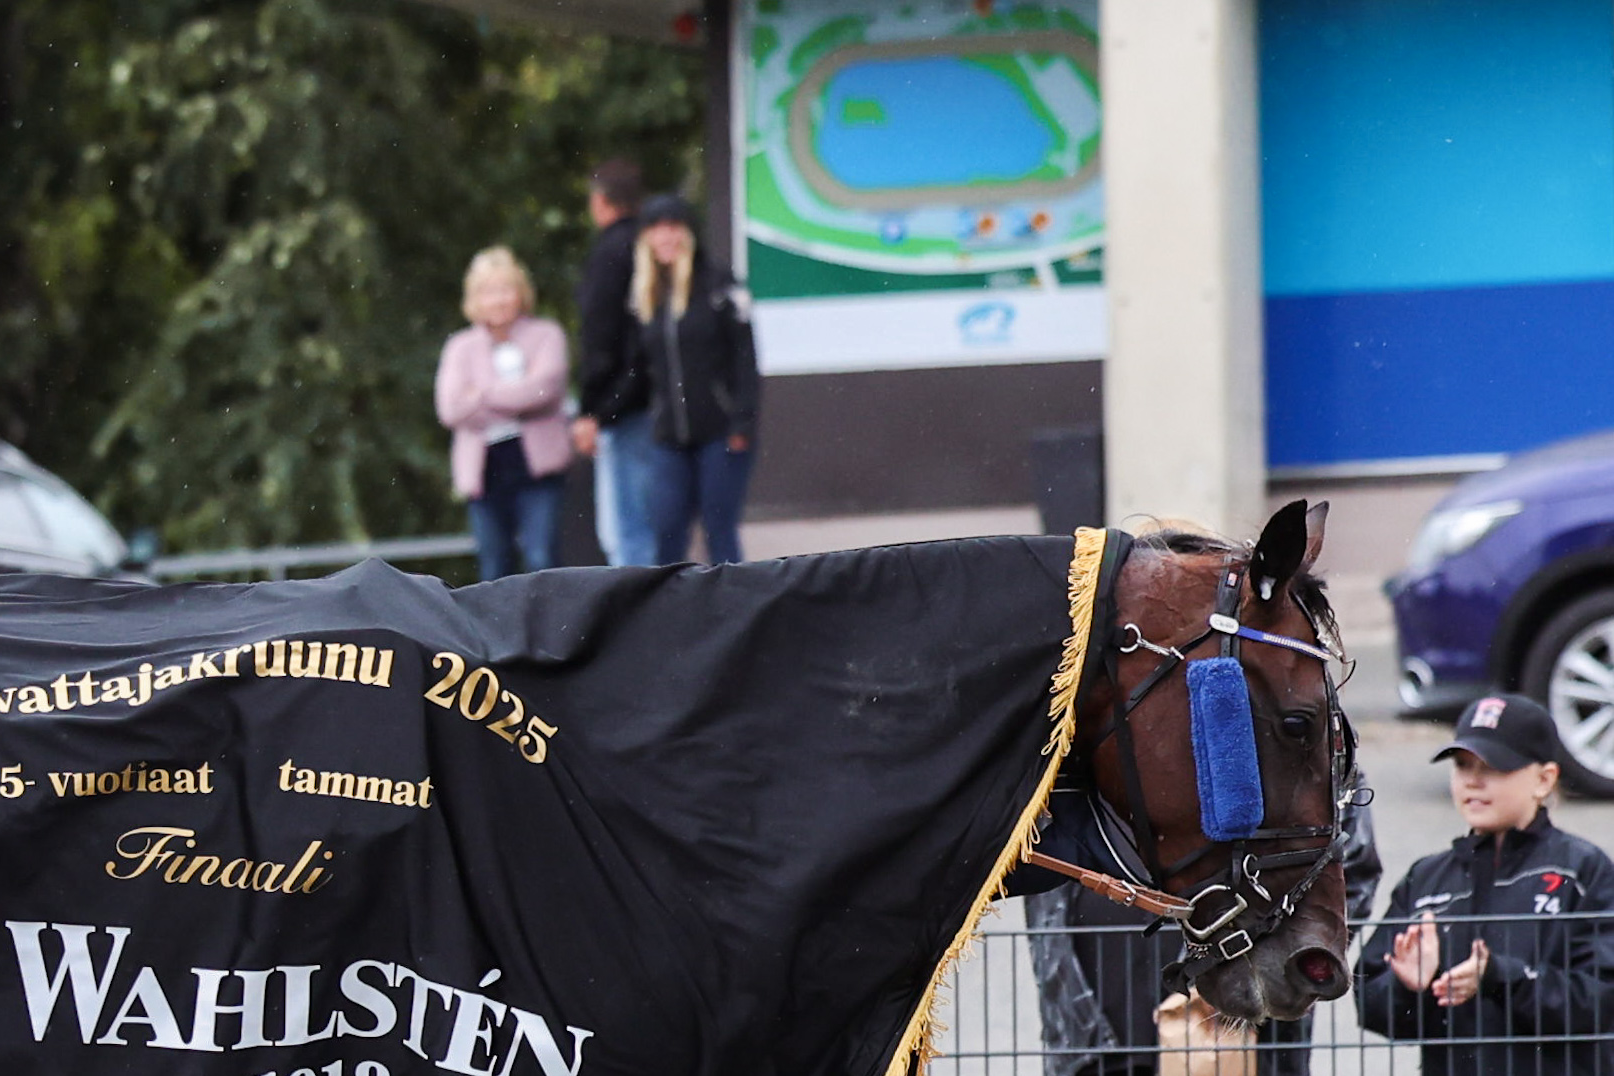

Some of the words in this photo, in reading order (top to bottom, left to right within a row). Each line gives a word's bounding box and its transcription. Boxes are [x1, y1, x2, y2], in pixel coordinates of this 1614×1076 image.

[423, 651, 559, 766] 2025
[48, 760, 214, 798] vuotiaat
[278, 758, 434, 810] tammat
[104, 827, 333, 895] Finaali
[1534, 894, 1560, 915] 74
